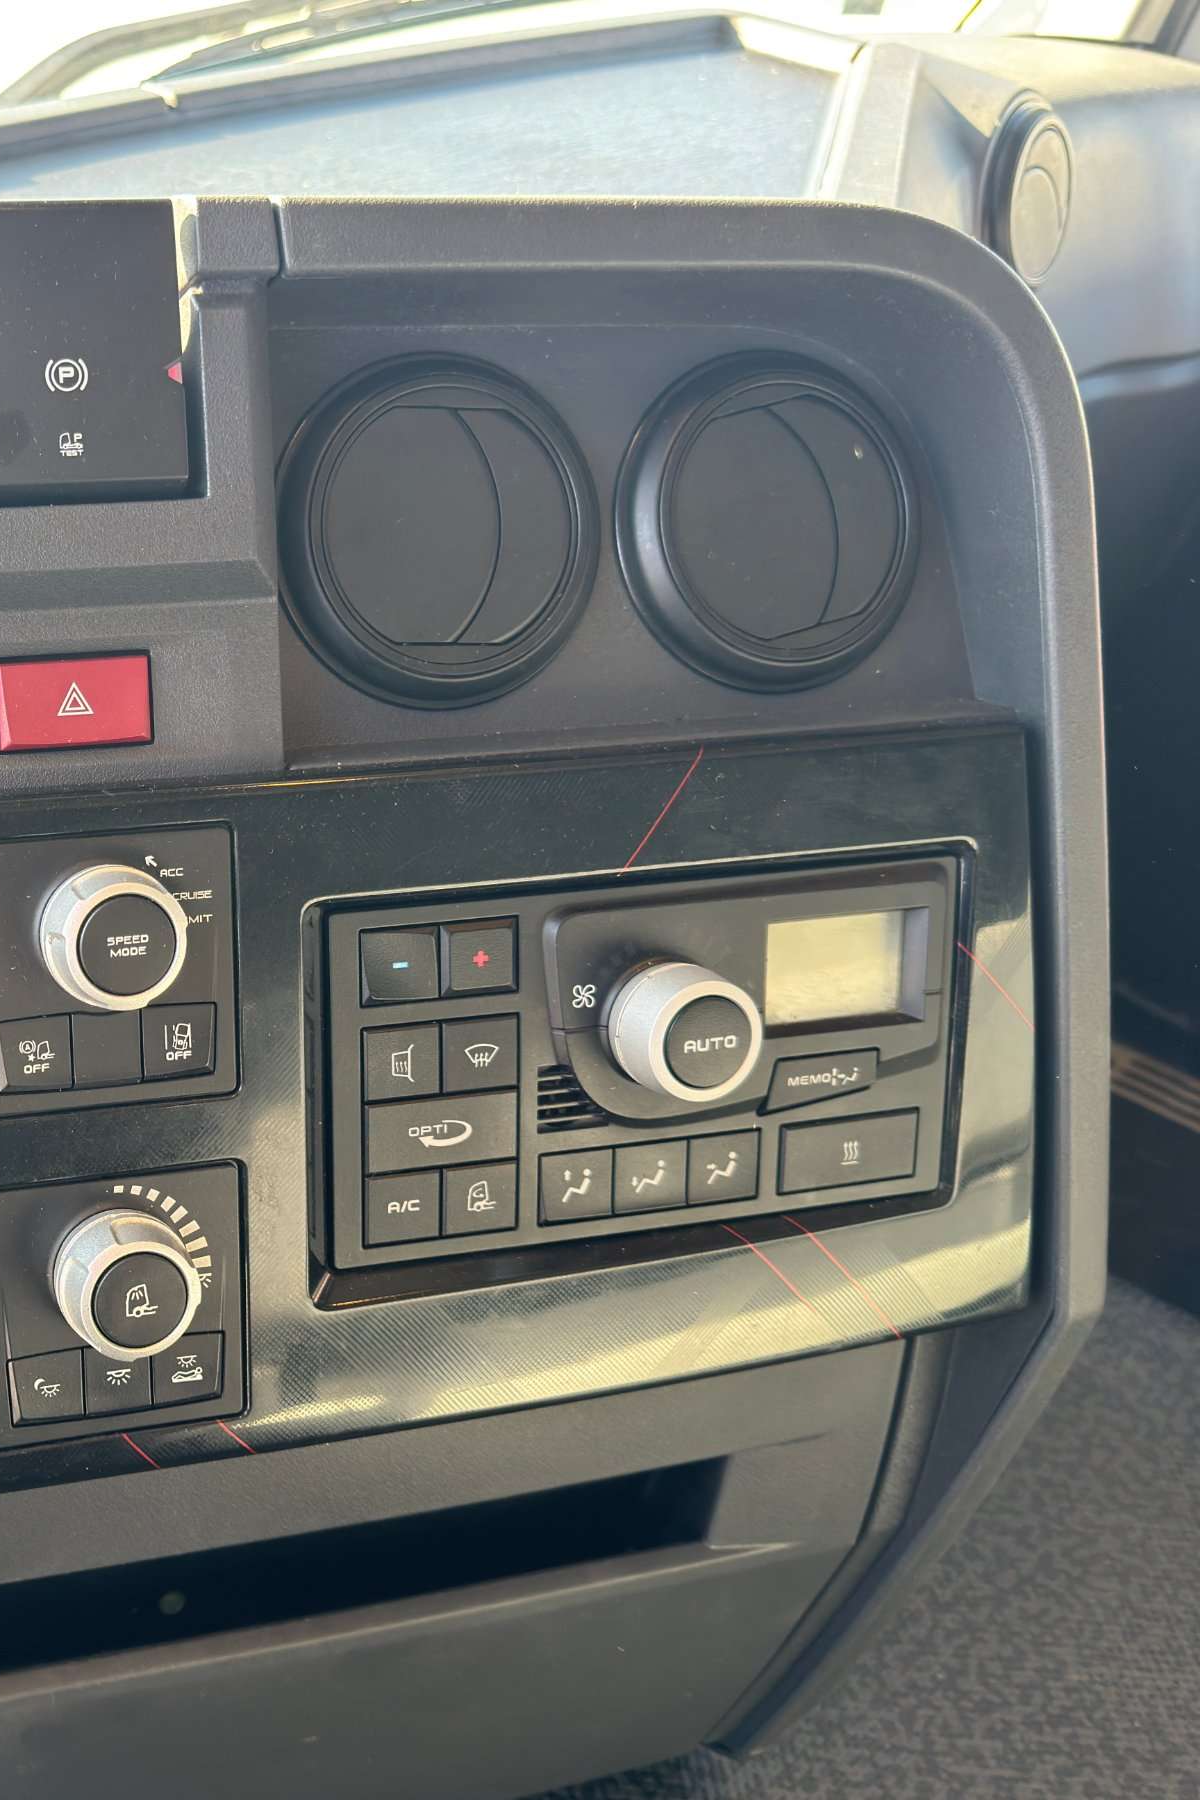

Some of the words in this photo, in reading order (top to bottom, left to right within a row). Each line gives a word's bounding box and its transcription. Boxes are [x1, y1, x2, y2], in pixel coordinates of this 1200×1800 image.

[59, 449, 84, 457] TEST
[159, 867, 184, 878] ACC
[172, 889, 213, 901] CRUISE
[188, 913, 213, 924] MIT
[106, 933, 150, 947] SPEED
[109, 946, 148, 958] MODE
[683, 1034, 737, 1054] AUTO
[166, 1050, 193, 1062] OFF
[23, 1063, 51, 1074] OFF
[787, 1072, 832, 1087] MEMO
[408, 1123, 448, 1137] OPTI
[387, 1199, 421, 1214] A/C
